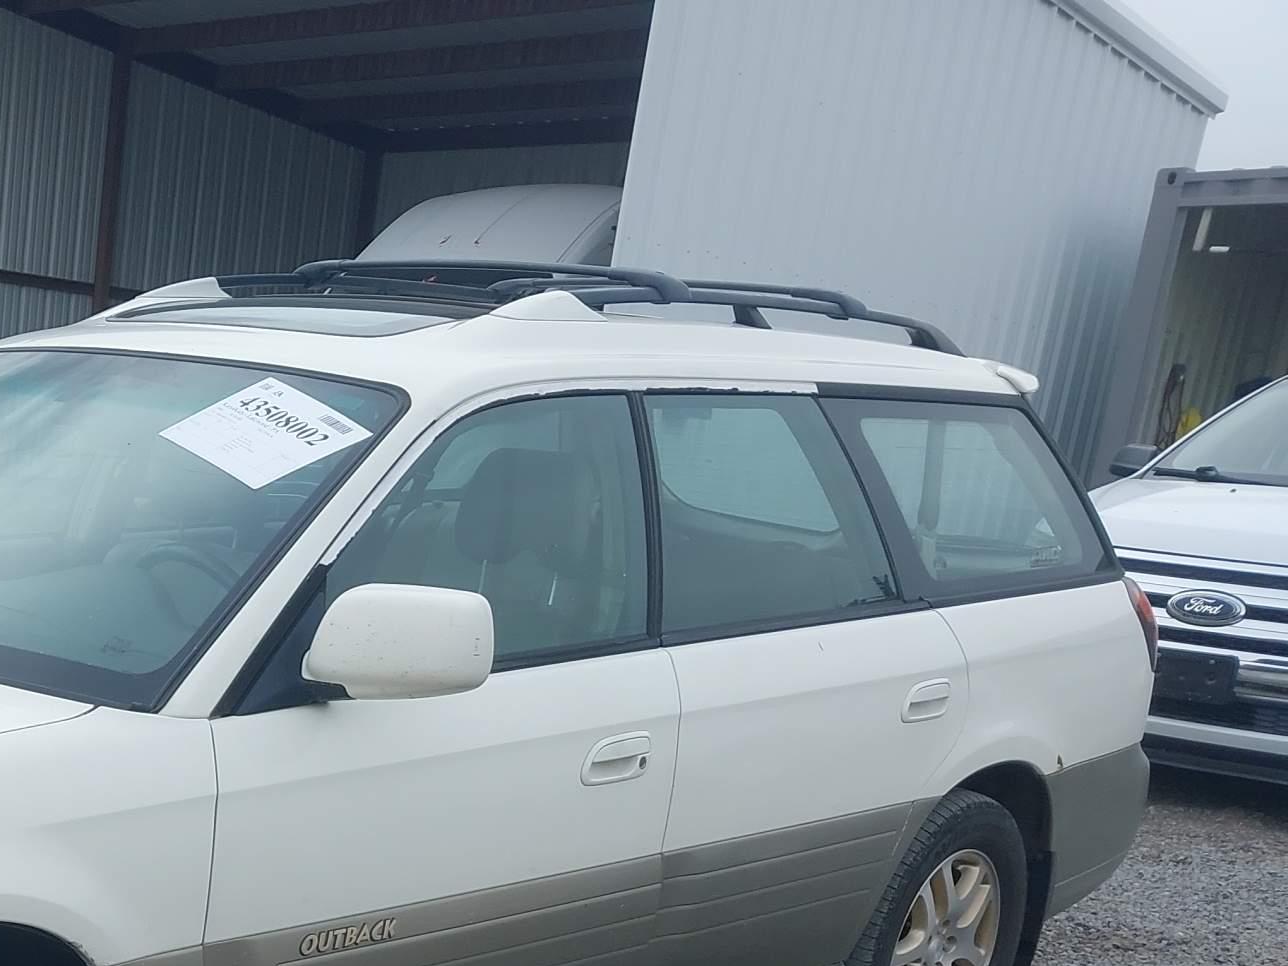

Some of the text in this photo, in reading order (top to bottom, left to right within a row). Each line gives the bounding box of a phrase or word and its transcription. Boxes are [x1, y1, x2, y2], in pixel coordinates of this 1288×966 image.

[239, 396, 330, 446] 43508002
[1183, 597, 1224, 616] Ford
[299, 917, 397, 957] OUTBACK
